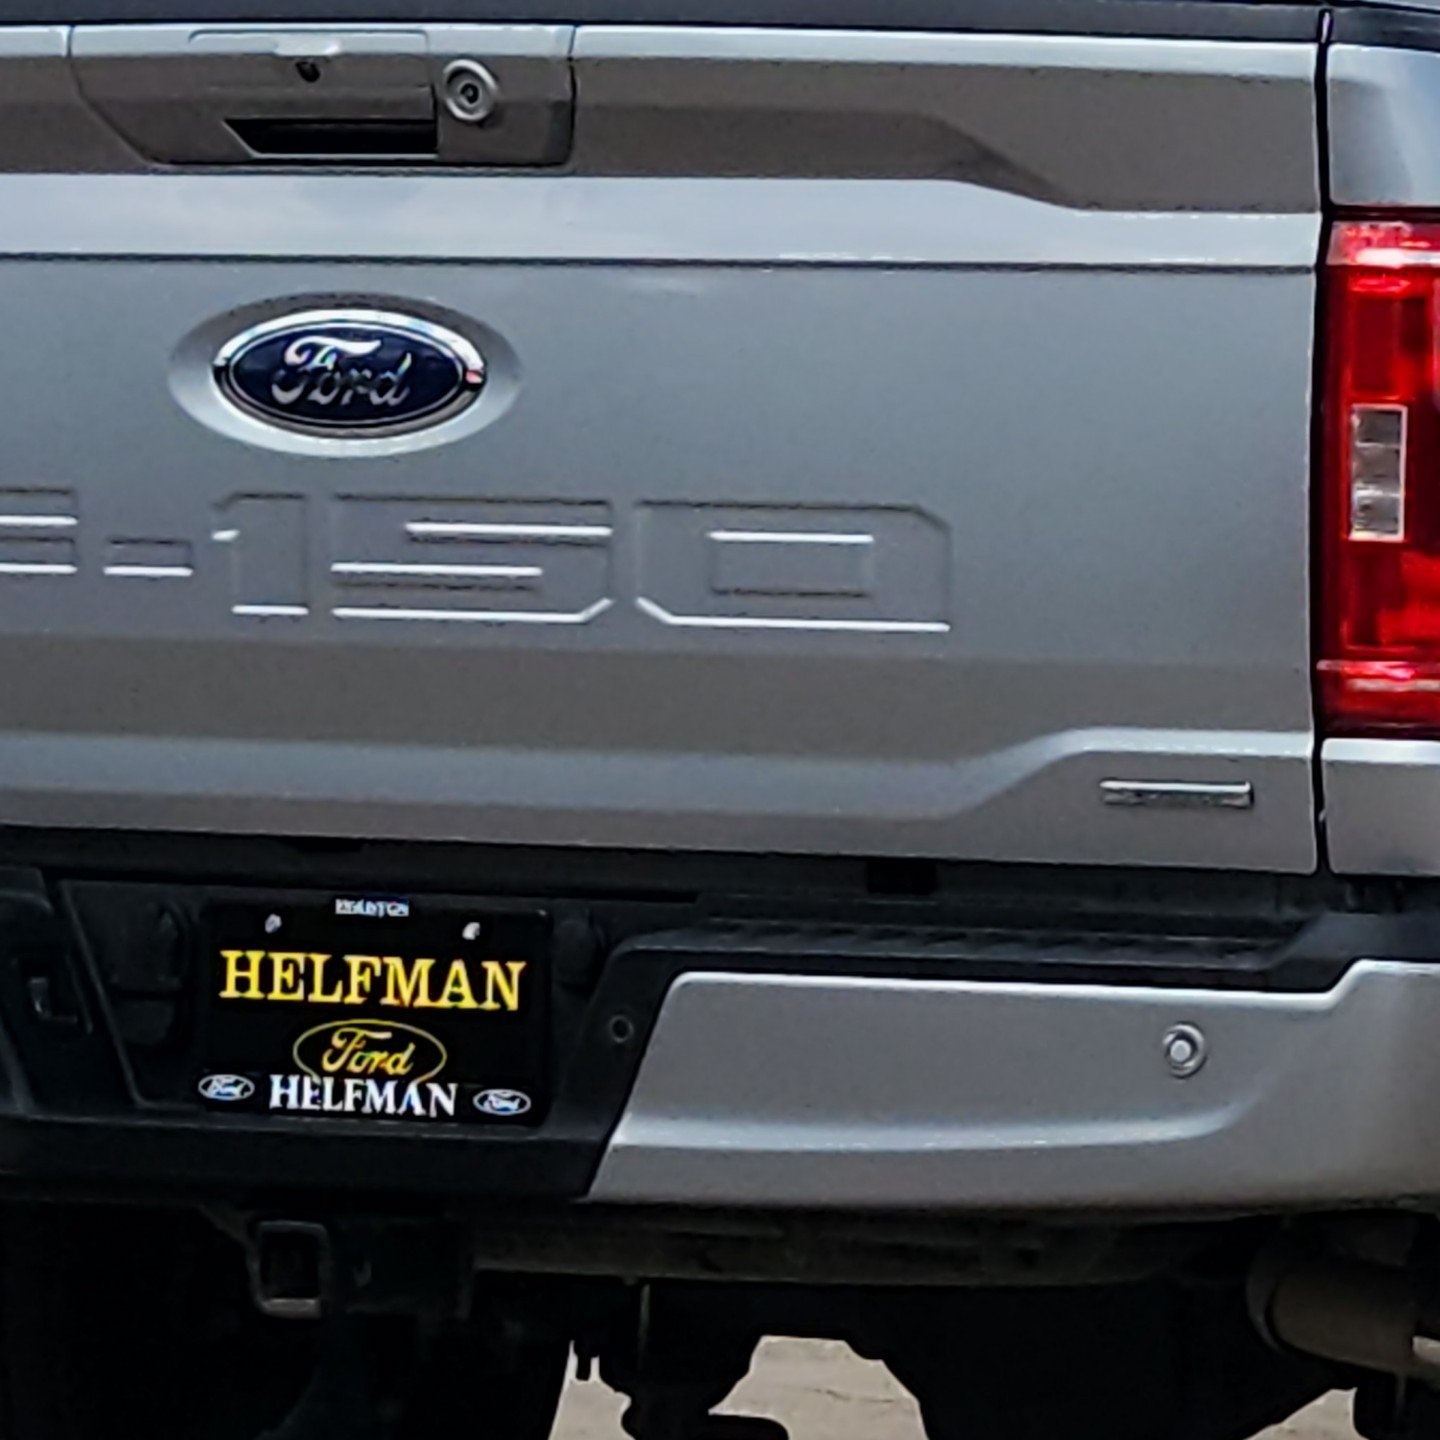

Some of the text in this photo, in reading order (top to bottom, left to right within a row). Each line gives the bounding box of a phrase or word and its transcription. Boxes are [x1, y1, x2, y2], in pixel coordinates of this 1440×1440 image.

[271, 335, 412, 405] Ford
[217, 948, 528, 1012] HELFMAN
[321, 1026, 417, 1077] Ford
[268, 1073, 459, 1118] HELFMAN
